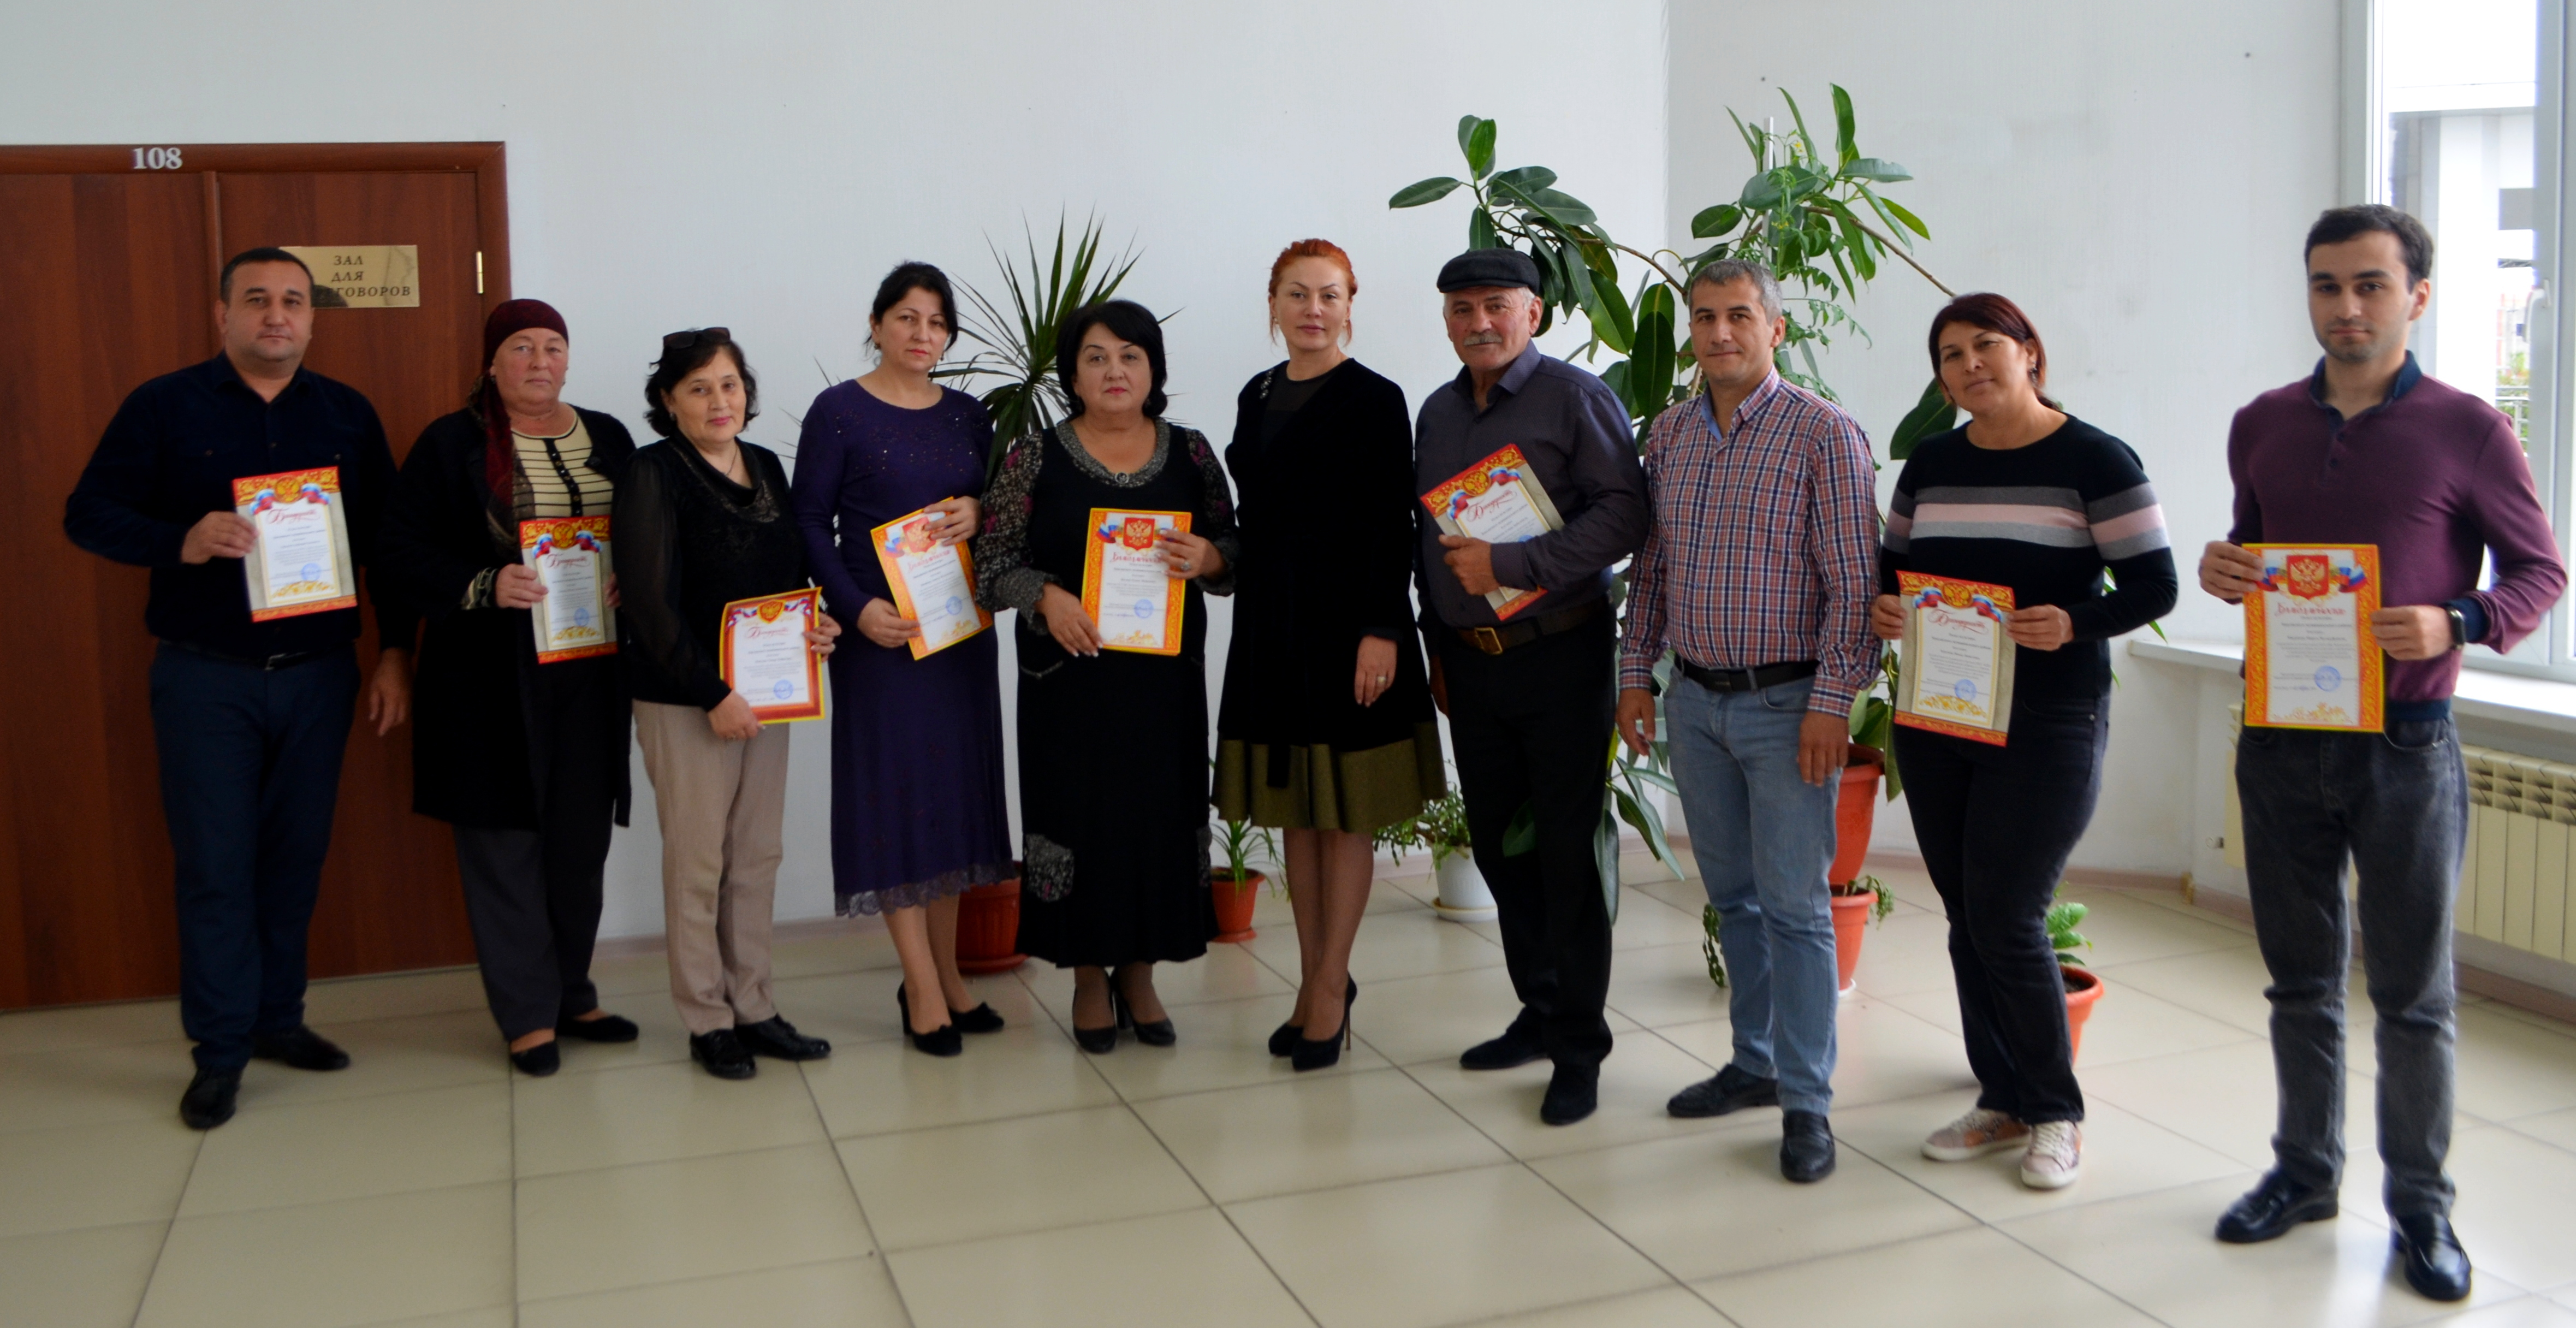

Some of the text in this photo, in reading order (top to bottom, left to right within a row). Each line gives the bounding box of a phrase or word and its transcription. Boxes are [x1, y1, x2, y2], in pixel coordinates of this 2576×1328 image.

[133, 147, 183, 169] 108
[334, 255, 363, 265] ЗАЛ
[331, 271, 363, 282] ДЛЯ
[327, 286, 411, 297] ГОВОРОВ
